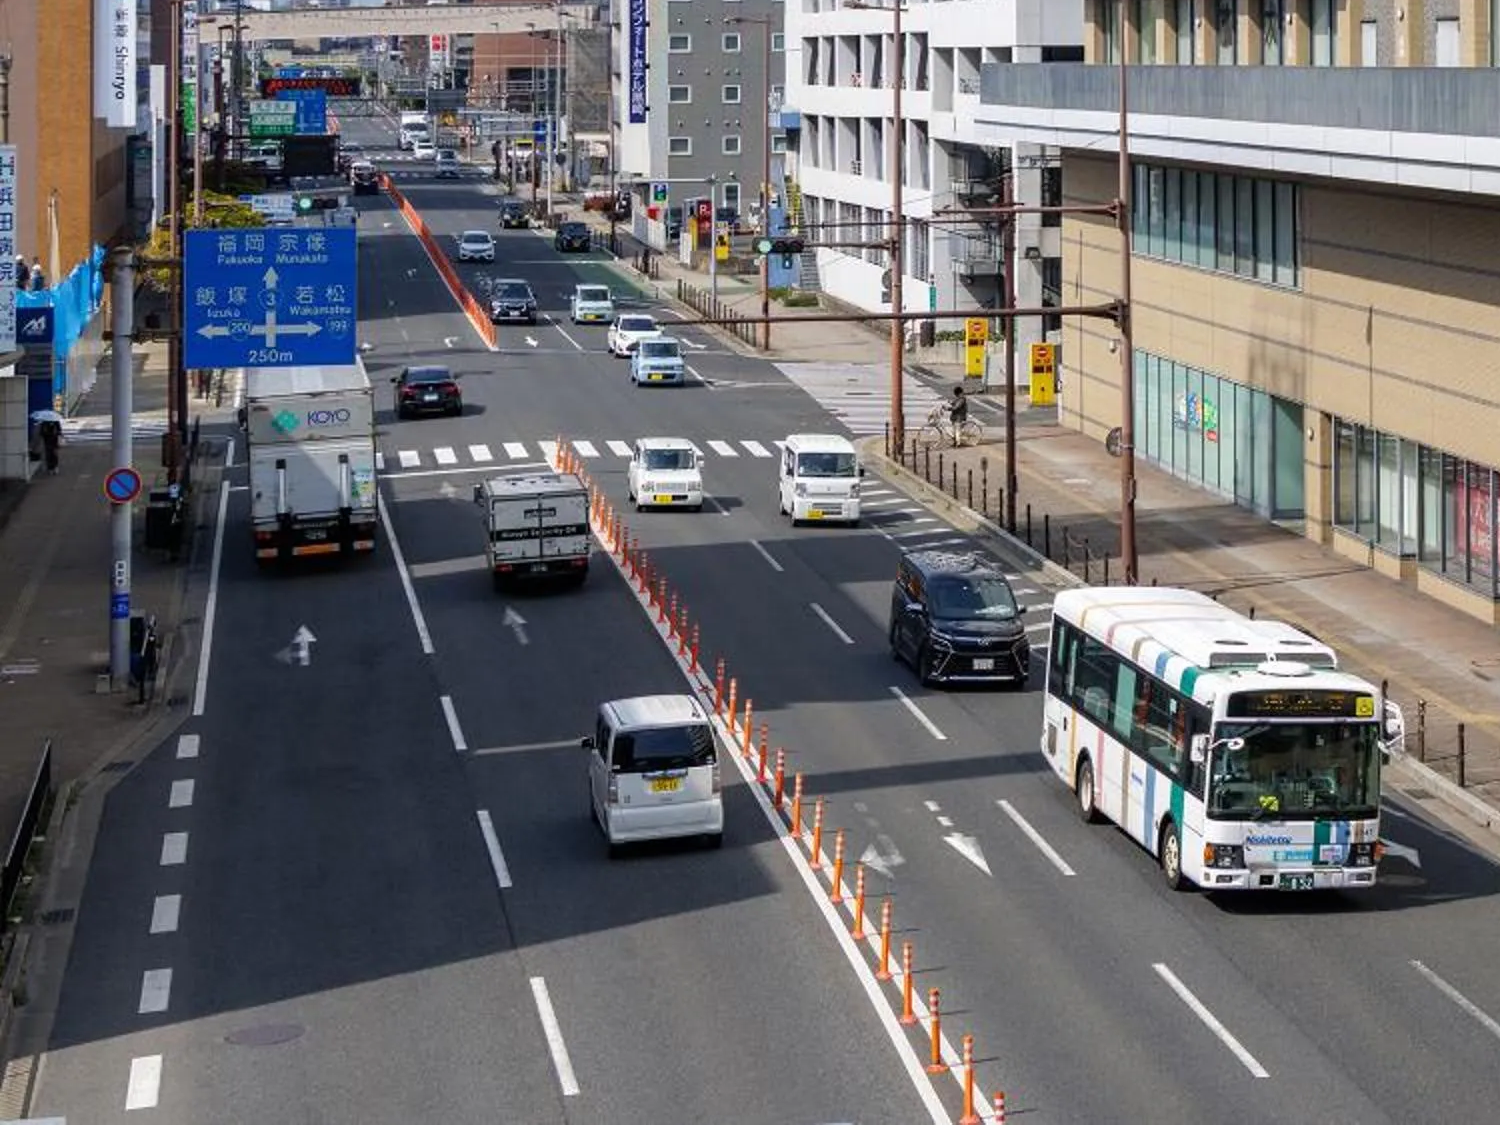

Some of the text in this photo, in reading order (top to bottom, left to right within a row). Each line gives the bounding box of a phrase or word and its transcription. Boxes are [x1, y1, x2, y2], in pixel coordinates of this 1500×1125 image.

[111, 45, 129, 100] Shinryo
[217, 232, 327, 253] 福岡 宗像
[217, 253, 329, 265] Fukuoka Munakata
[195, 286, 248, 307] 飯塚
[295, 284, 346, 305] 若松
[289, 304, 352, 316] Wakamatsu
[230, 322, 252, 332] 200
[247, 350, 294, 364] 250m
[307, 408, 351, 426] KOYO
